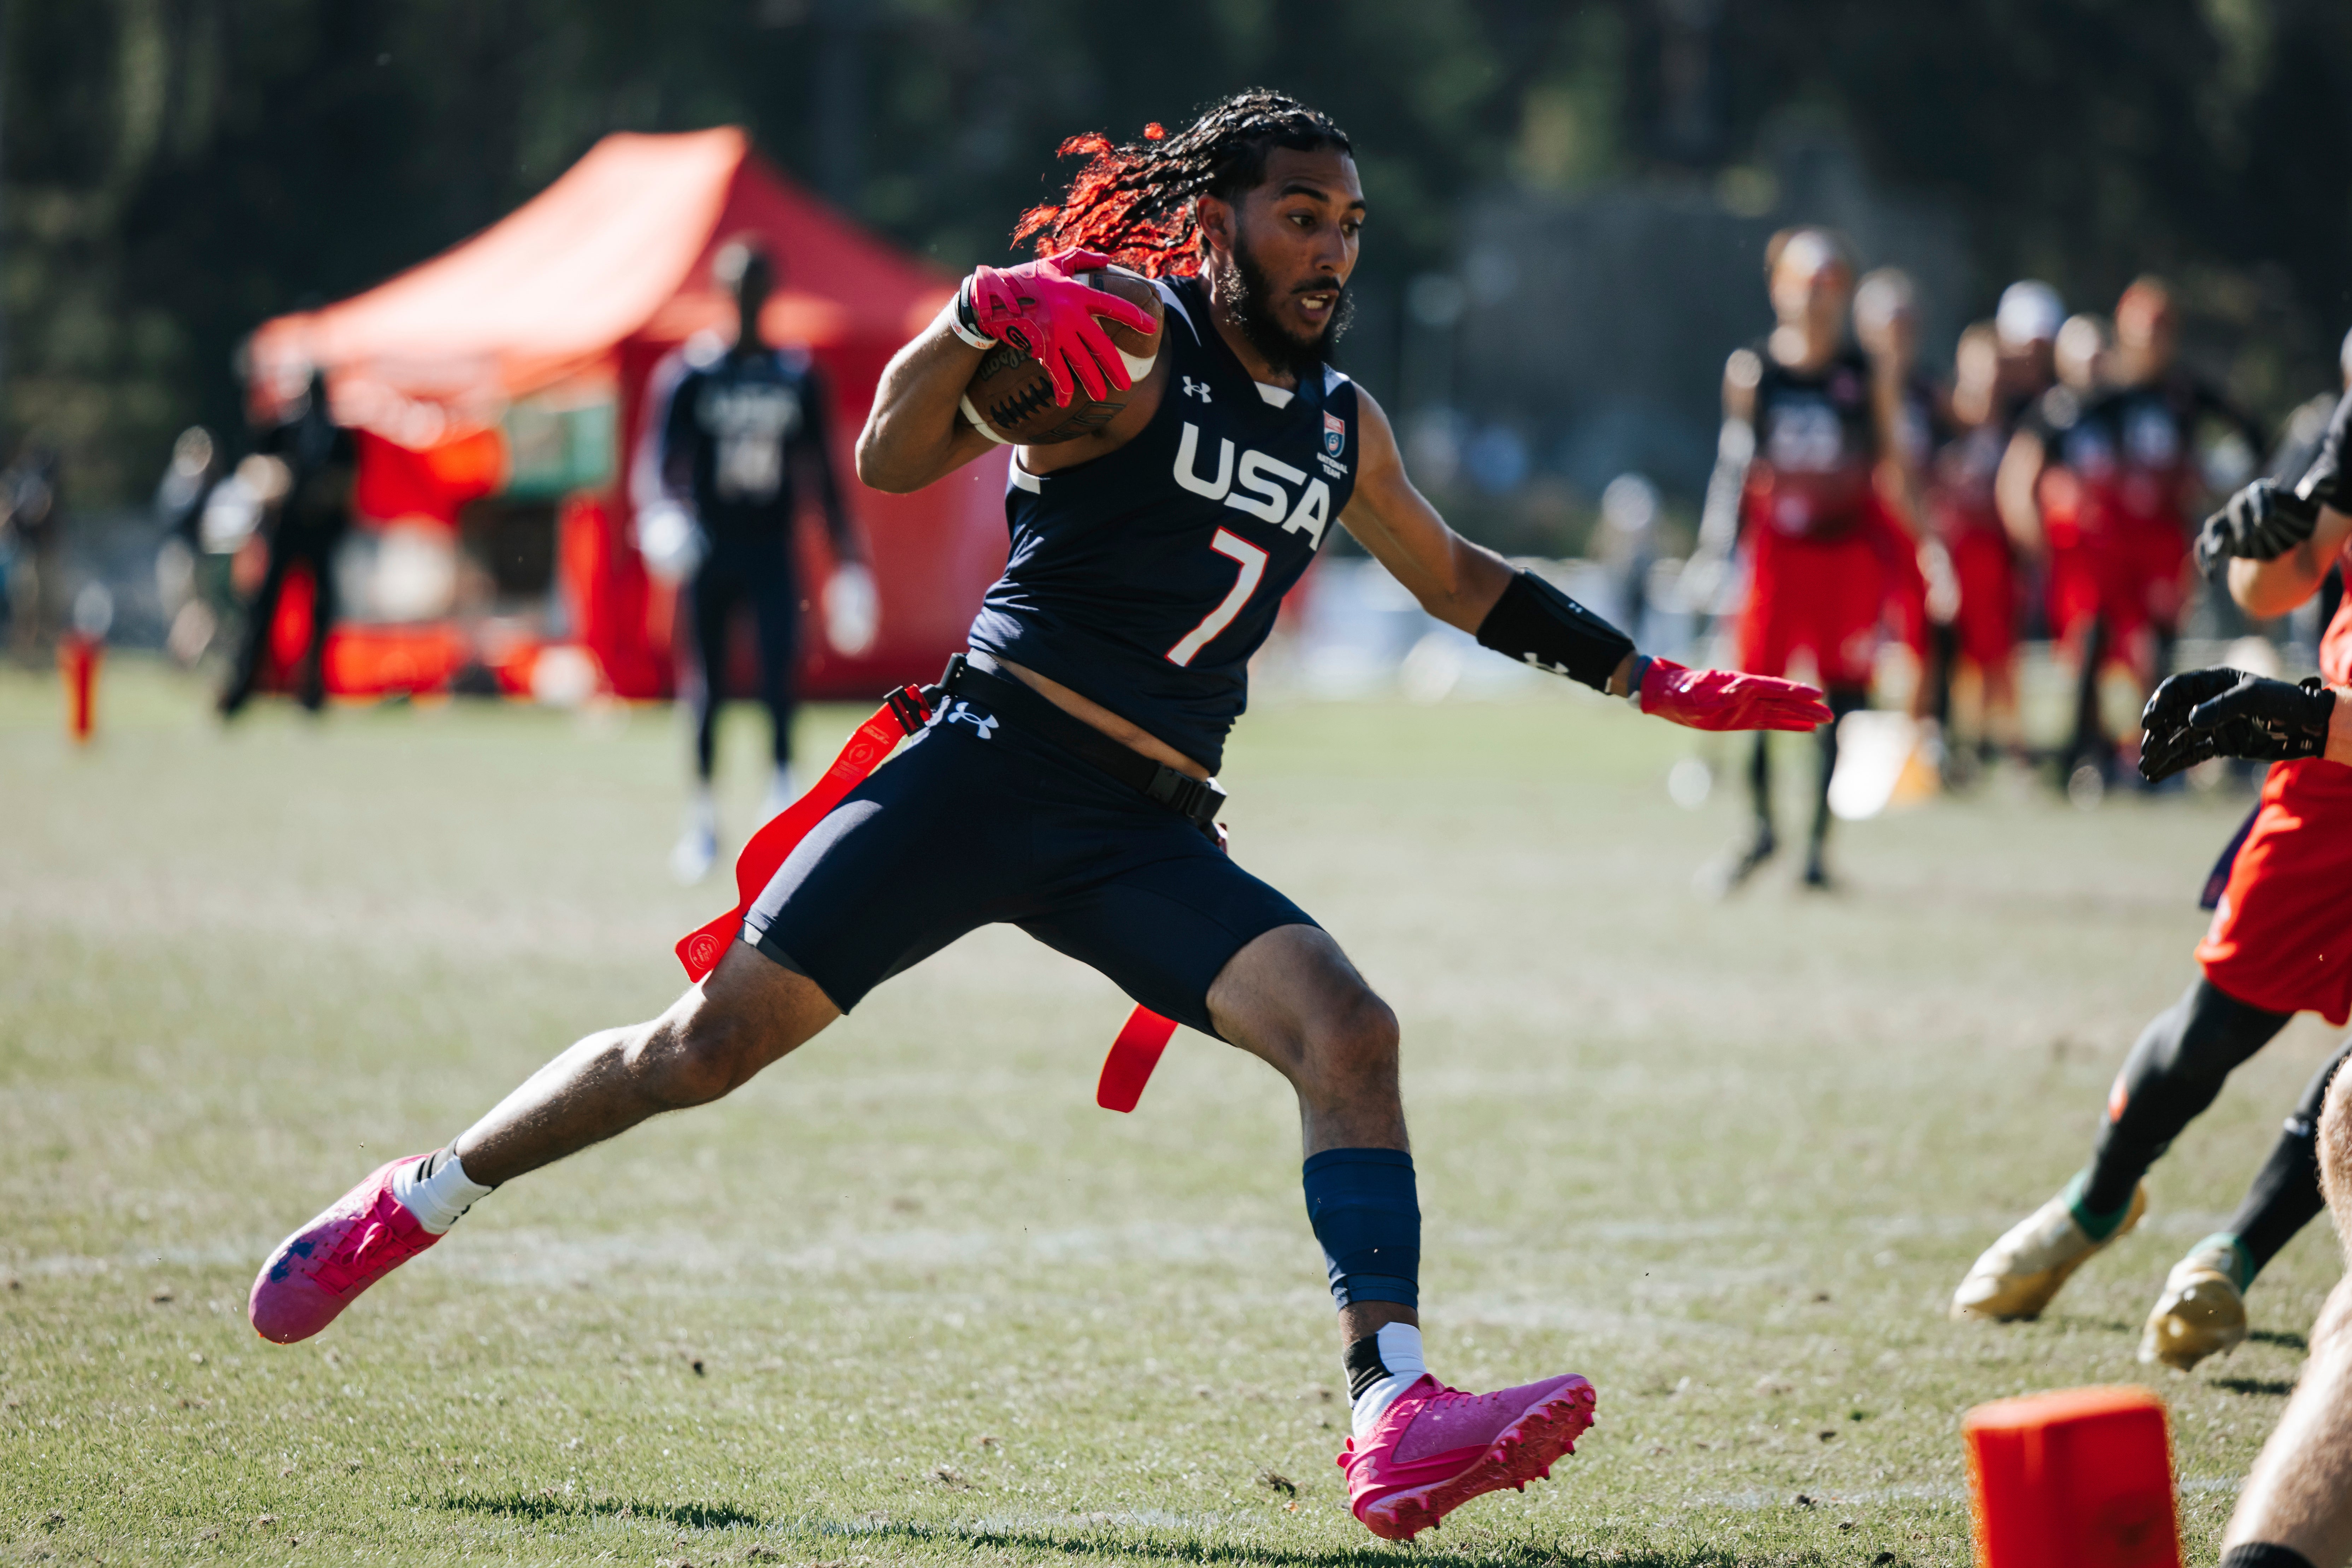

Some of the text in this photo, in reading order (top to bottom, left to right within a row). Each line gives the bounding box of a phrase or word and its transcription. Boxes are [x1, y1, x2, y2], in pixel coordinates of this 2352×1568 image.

[980, 347, 1031, 380] ilson
[1173, 421, 1330, 551] USA
[1164, 525, 1270, 667] 7
